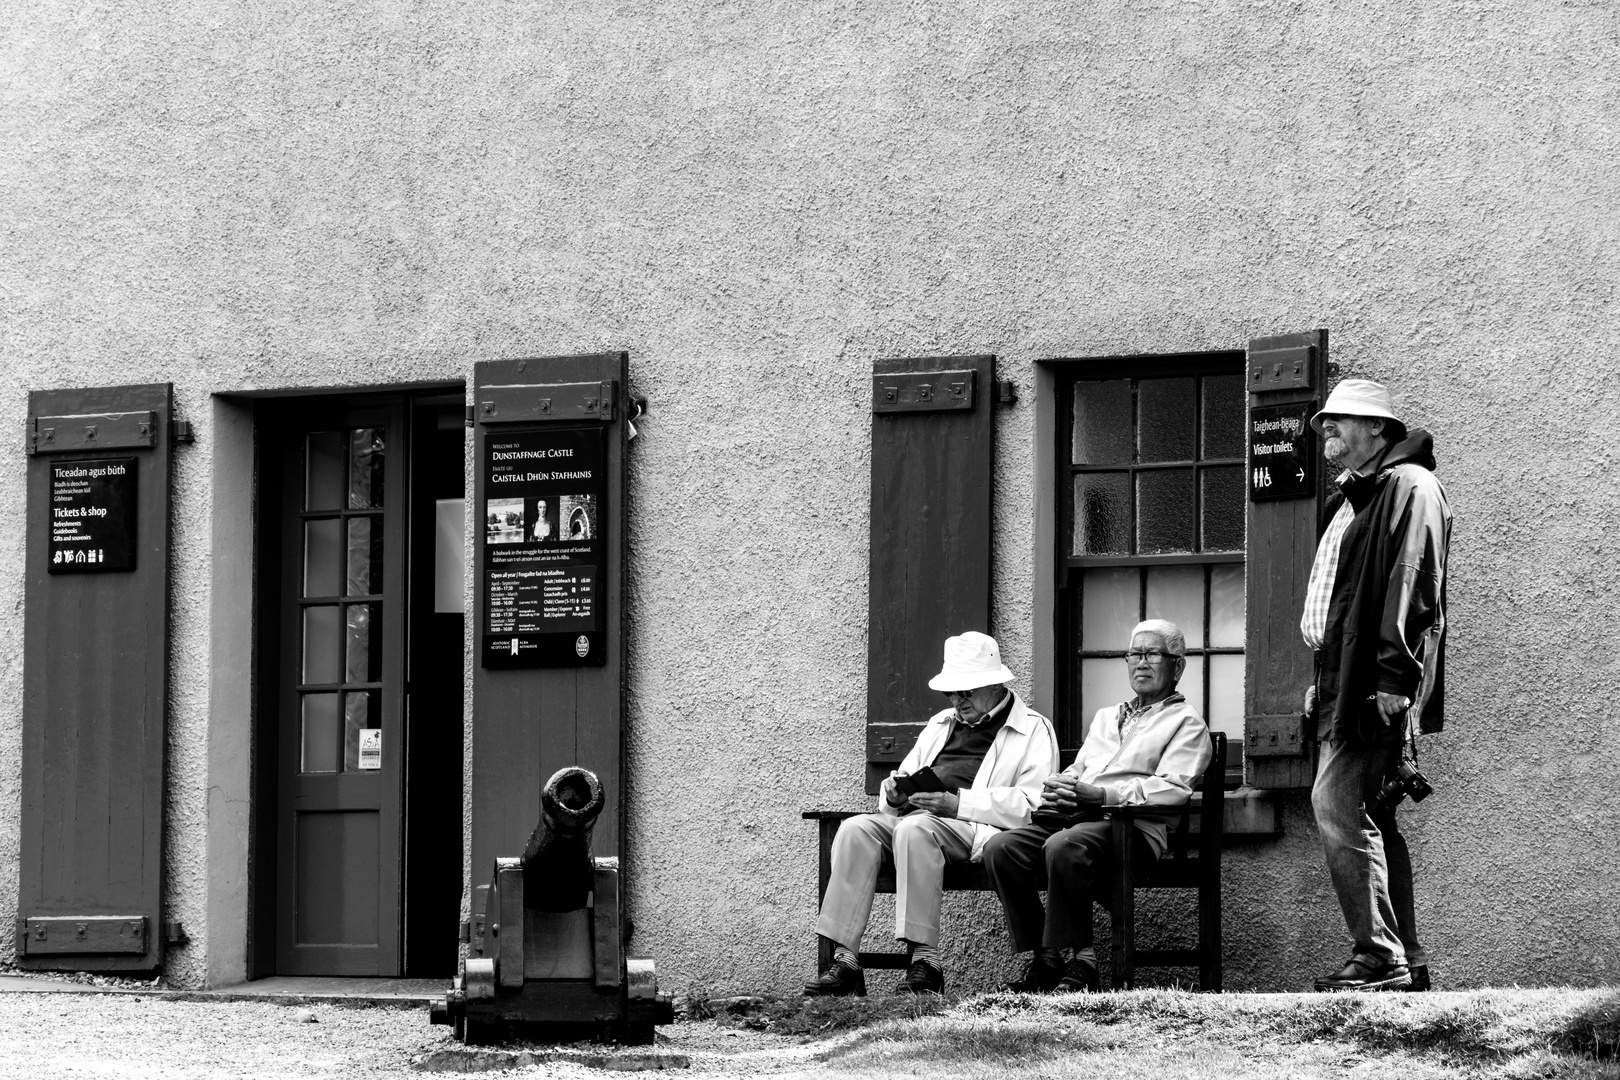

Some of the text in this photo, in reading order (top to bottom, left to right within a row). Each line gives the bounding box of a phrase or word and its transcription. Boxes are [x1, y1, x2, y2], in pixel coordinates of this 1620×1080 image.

[548, 449, 573, 457] CASTLE
[1253, 440, 1293, 455] Visitor toilets
[54, 465, 126, 478] Ticeadan agus bùth
[492, 474, 525, 483] CAISTEAL
[551, 471, 592, 480] STAFHAINIS
[54, 506, 107, 518] Tickets & shop
